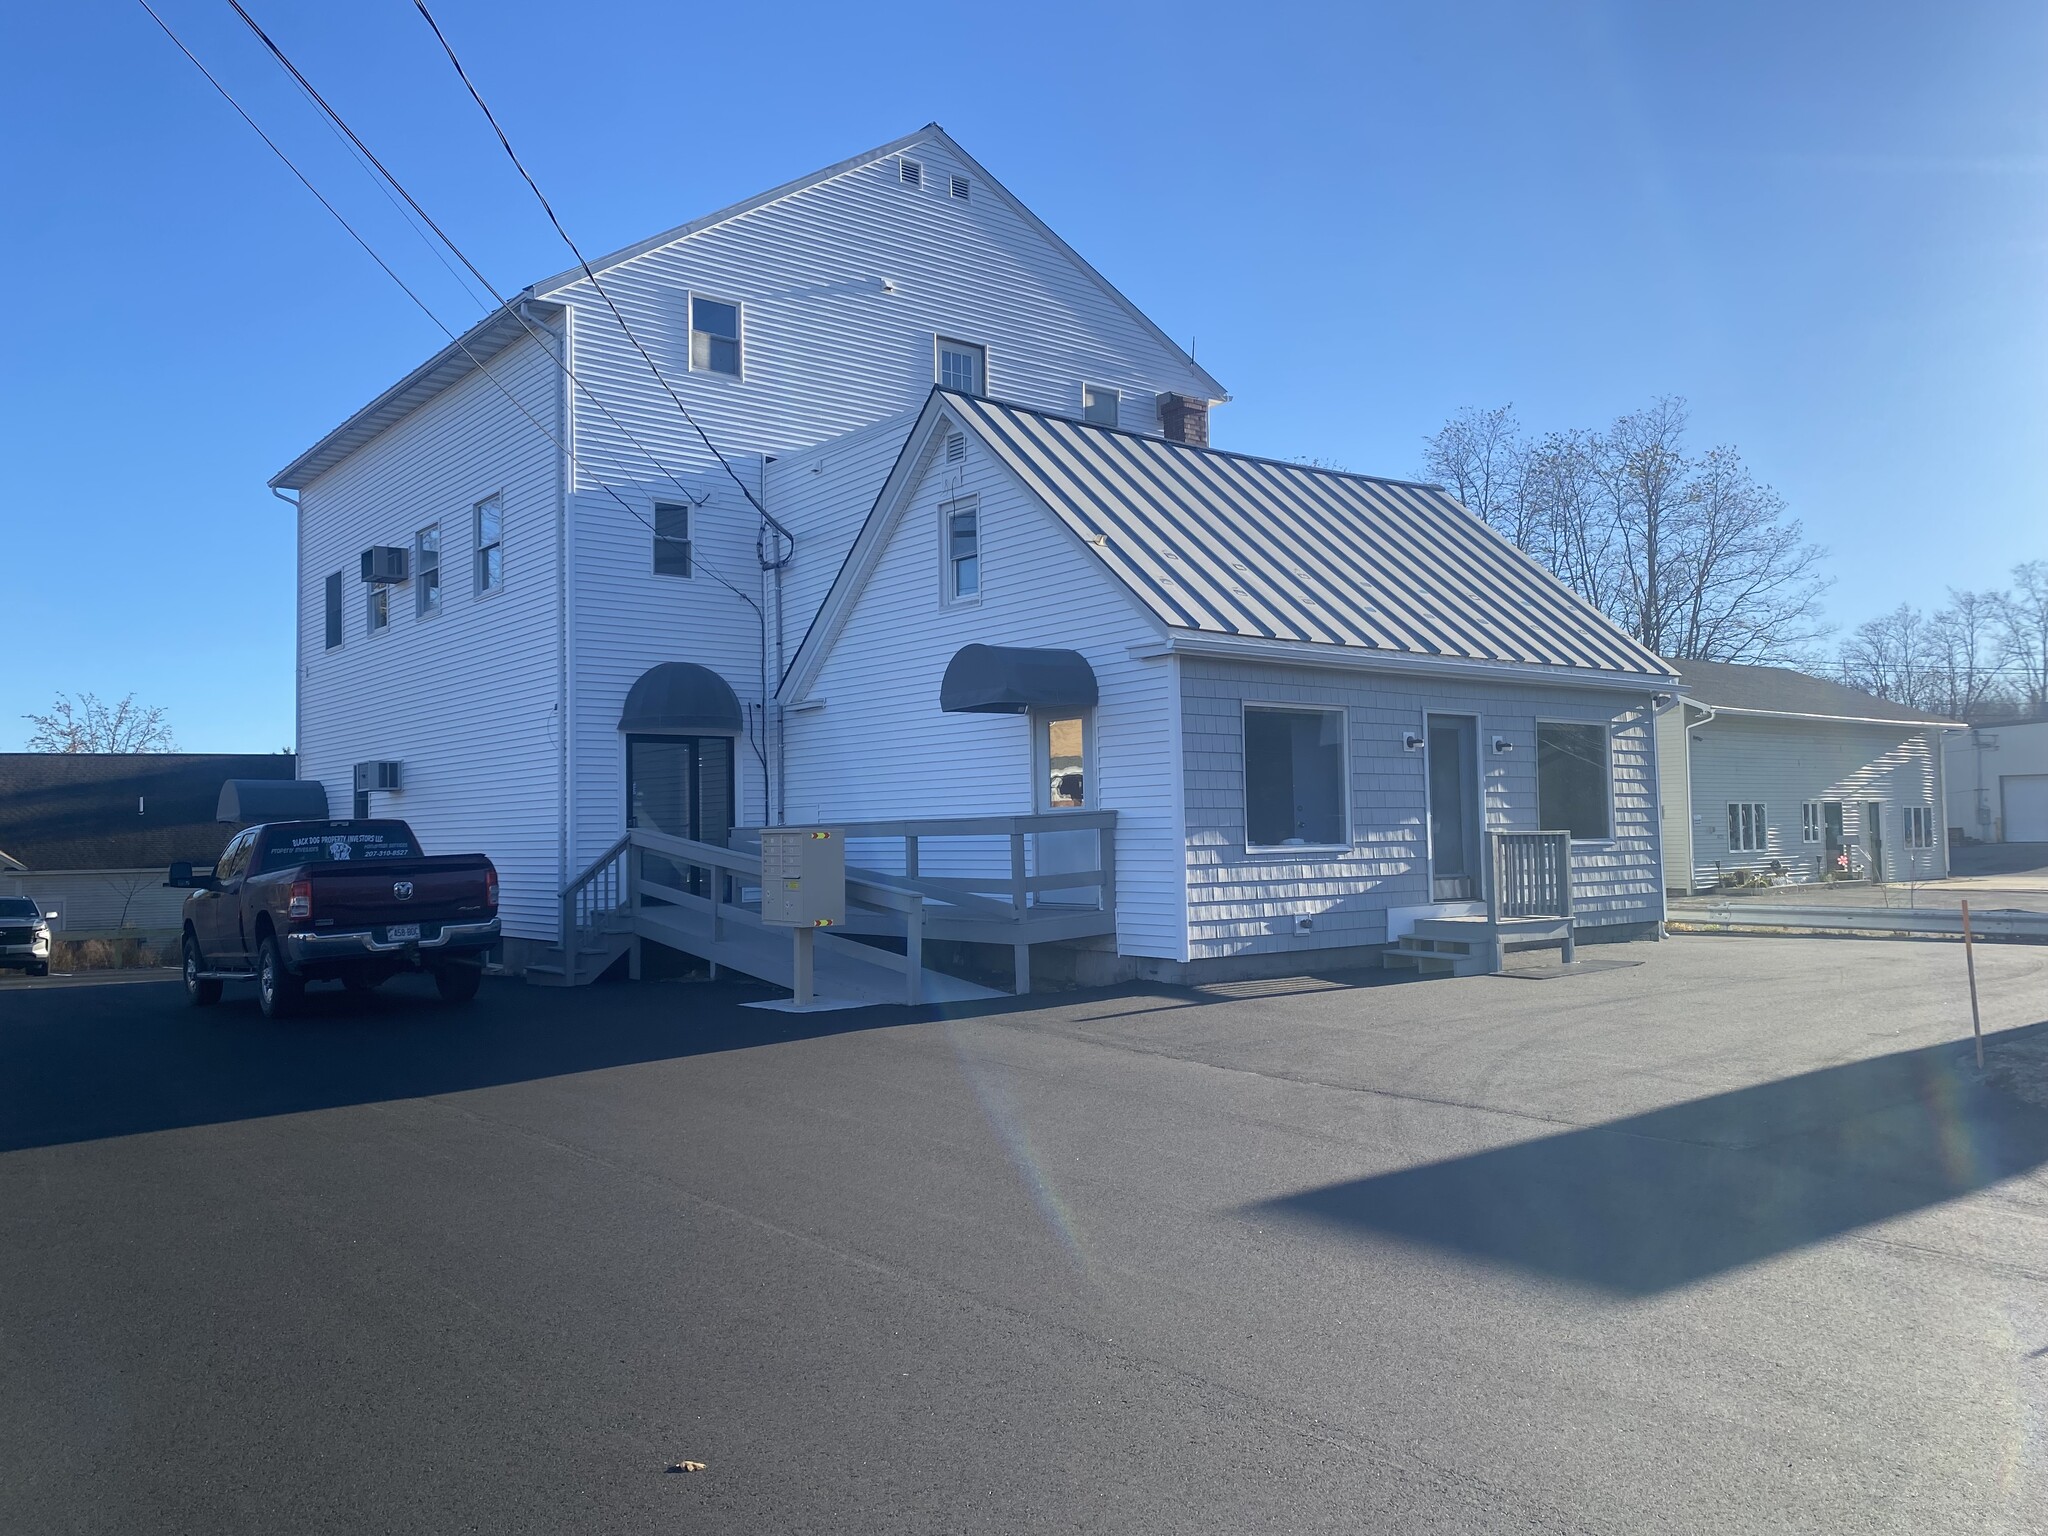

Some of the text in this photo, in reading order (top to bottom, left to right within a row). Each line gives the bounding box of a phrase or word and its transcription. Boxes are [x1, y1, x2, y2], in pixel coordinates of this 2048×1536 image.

[292, 834, 384, 847] BLACK DOG PROPERTY INVESTORS LLC
